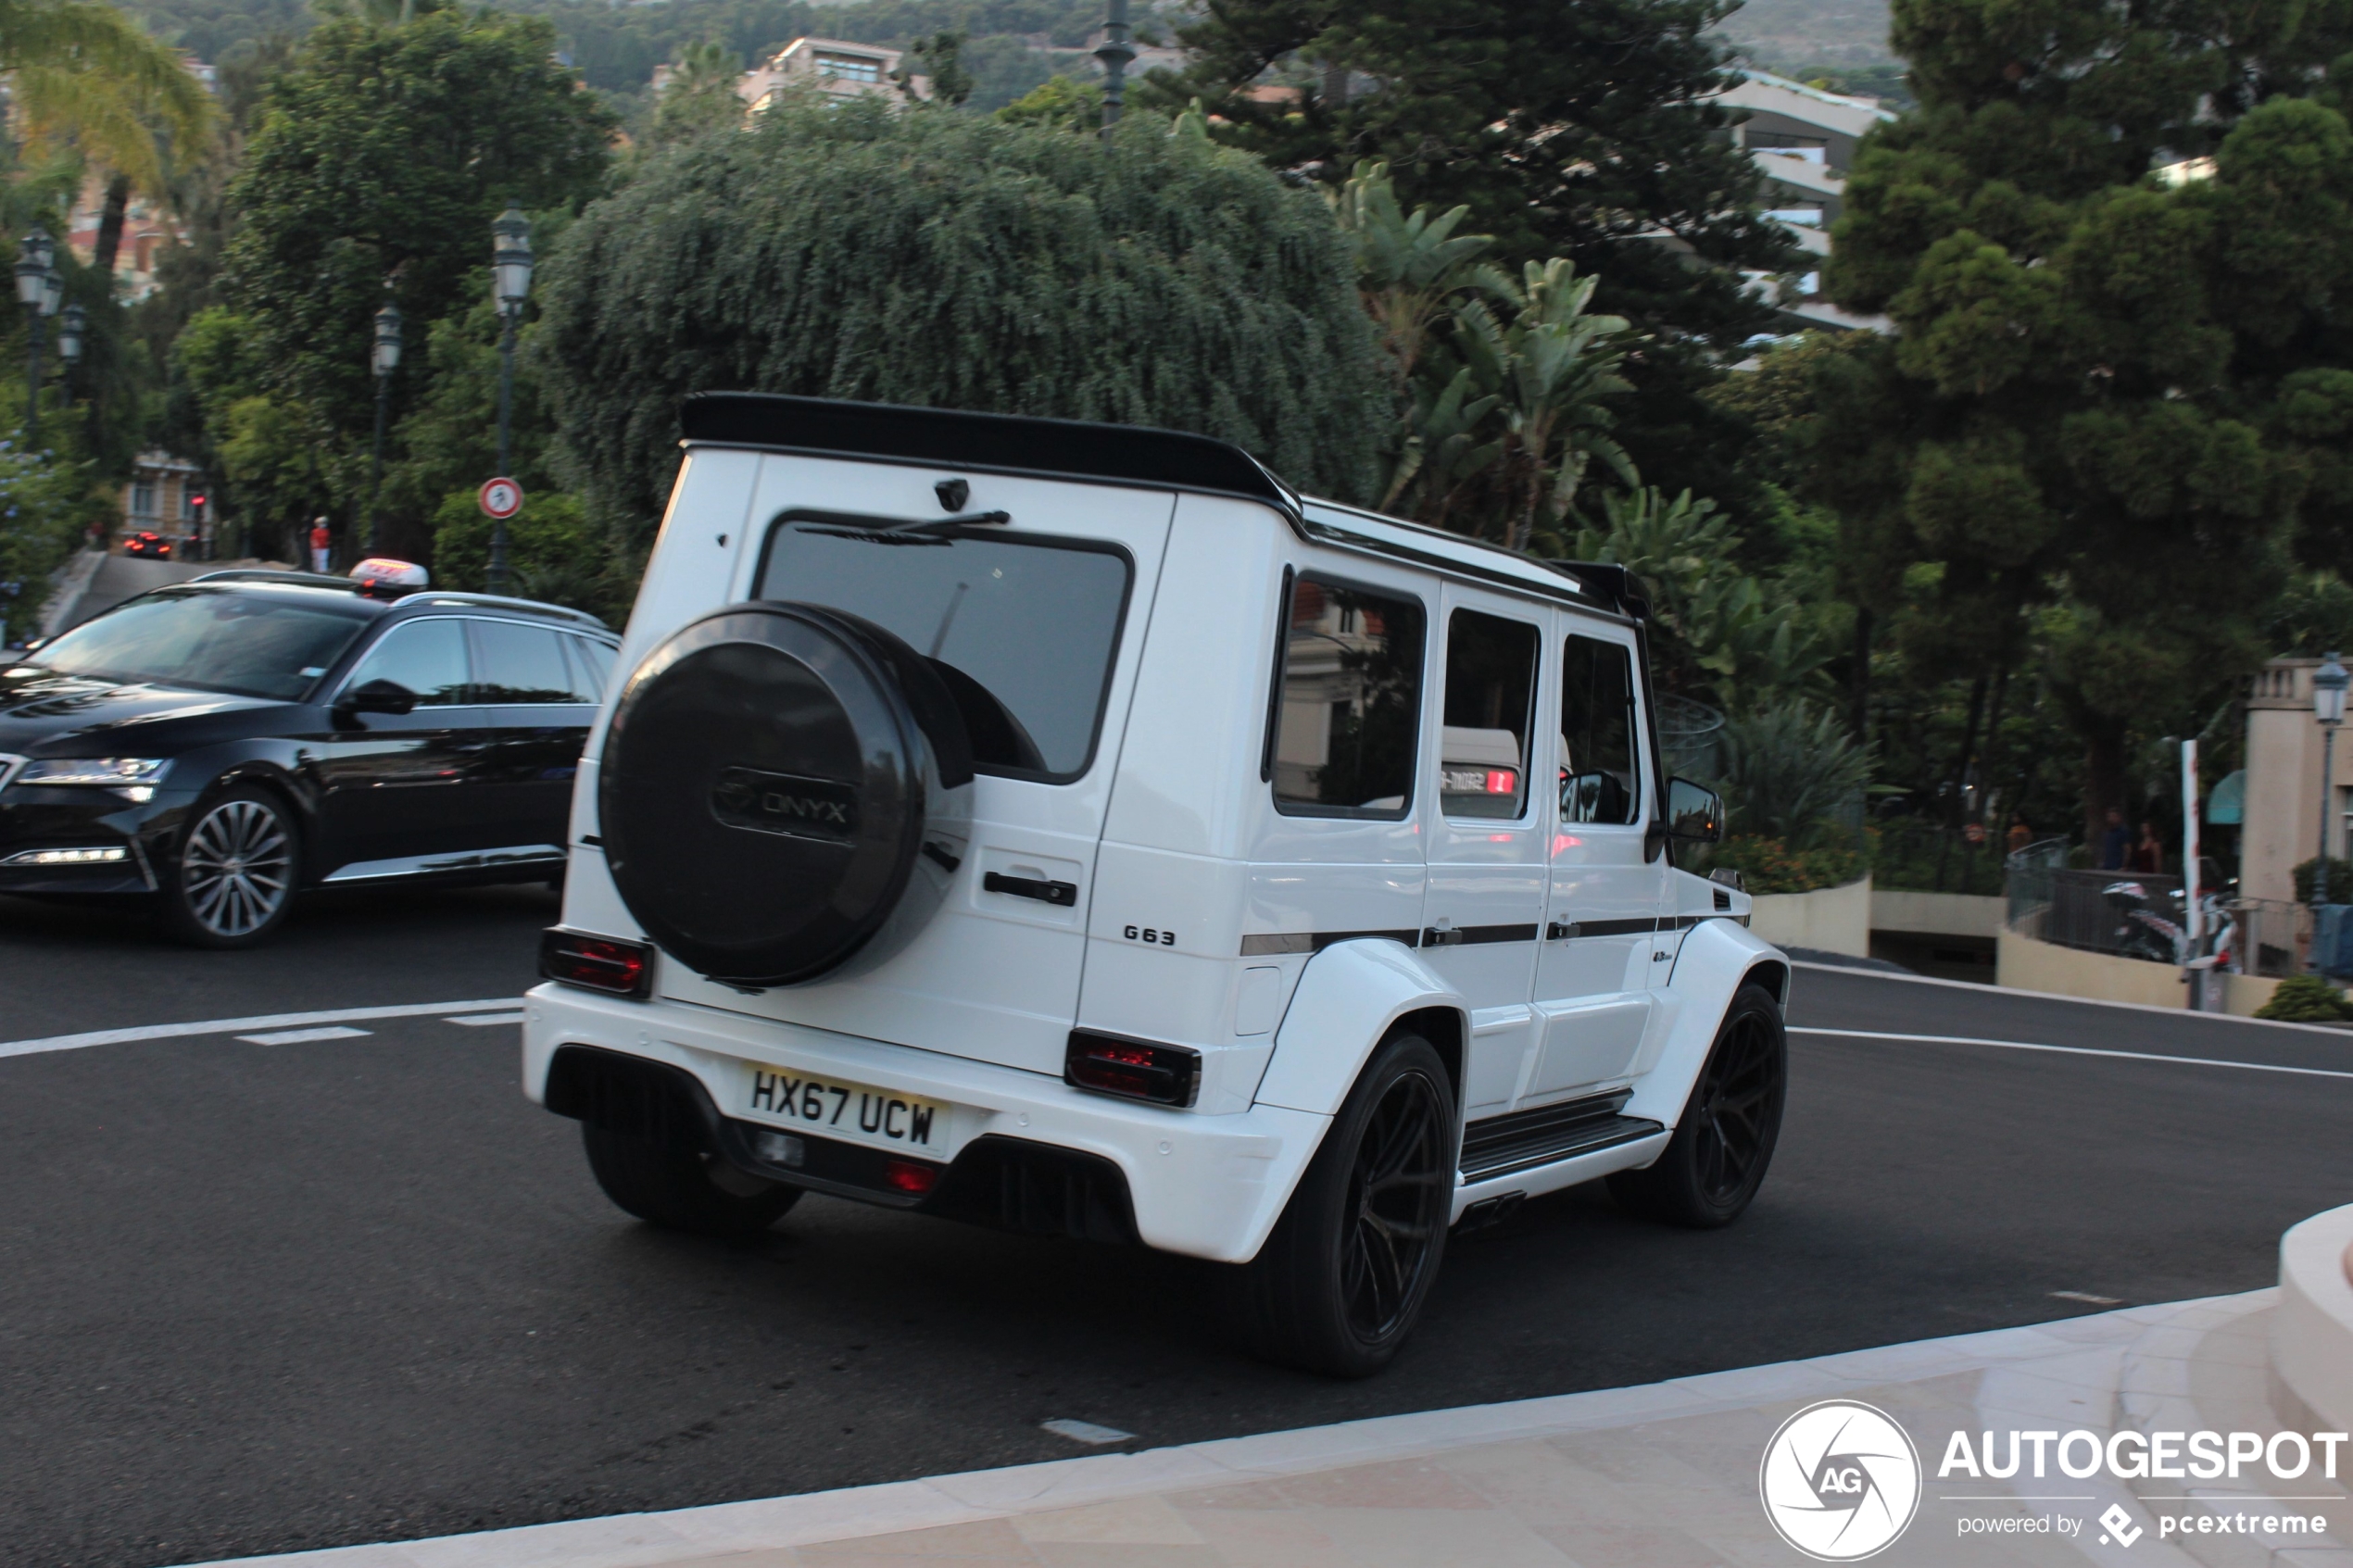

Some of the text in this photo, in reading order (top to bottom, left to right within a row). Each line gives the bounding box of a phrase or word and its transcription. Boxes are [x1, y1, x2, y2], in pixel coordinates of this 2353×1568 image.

[762, 792, 848, 824] ONYX
[1124, 924, 1176, 947] G63
[751, 1071, 935, 1145] HX67 UCW
